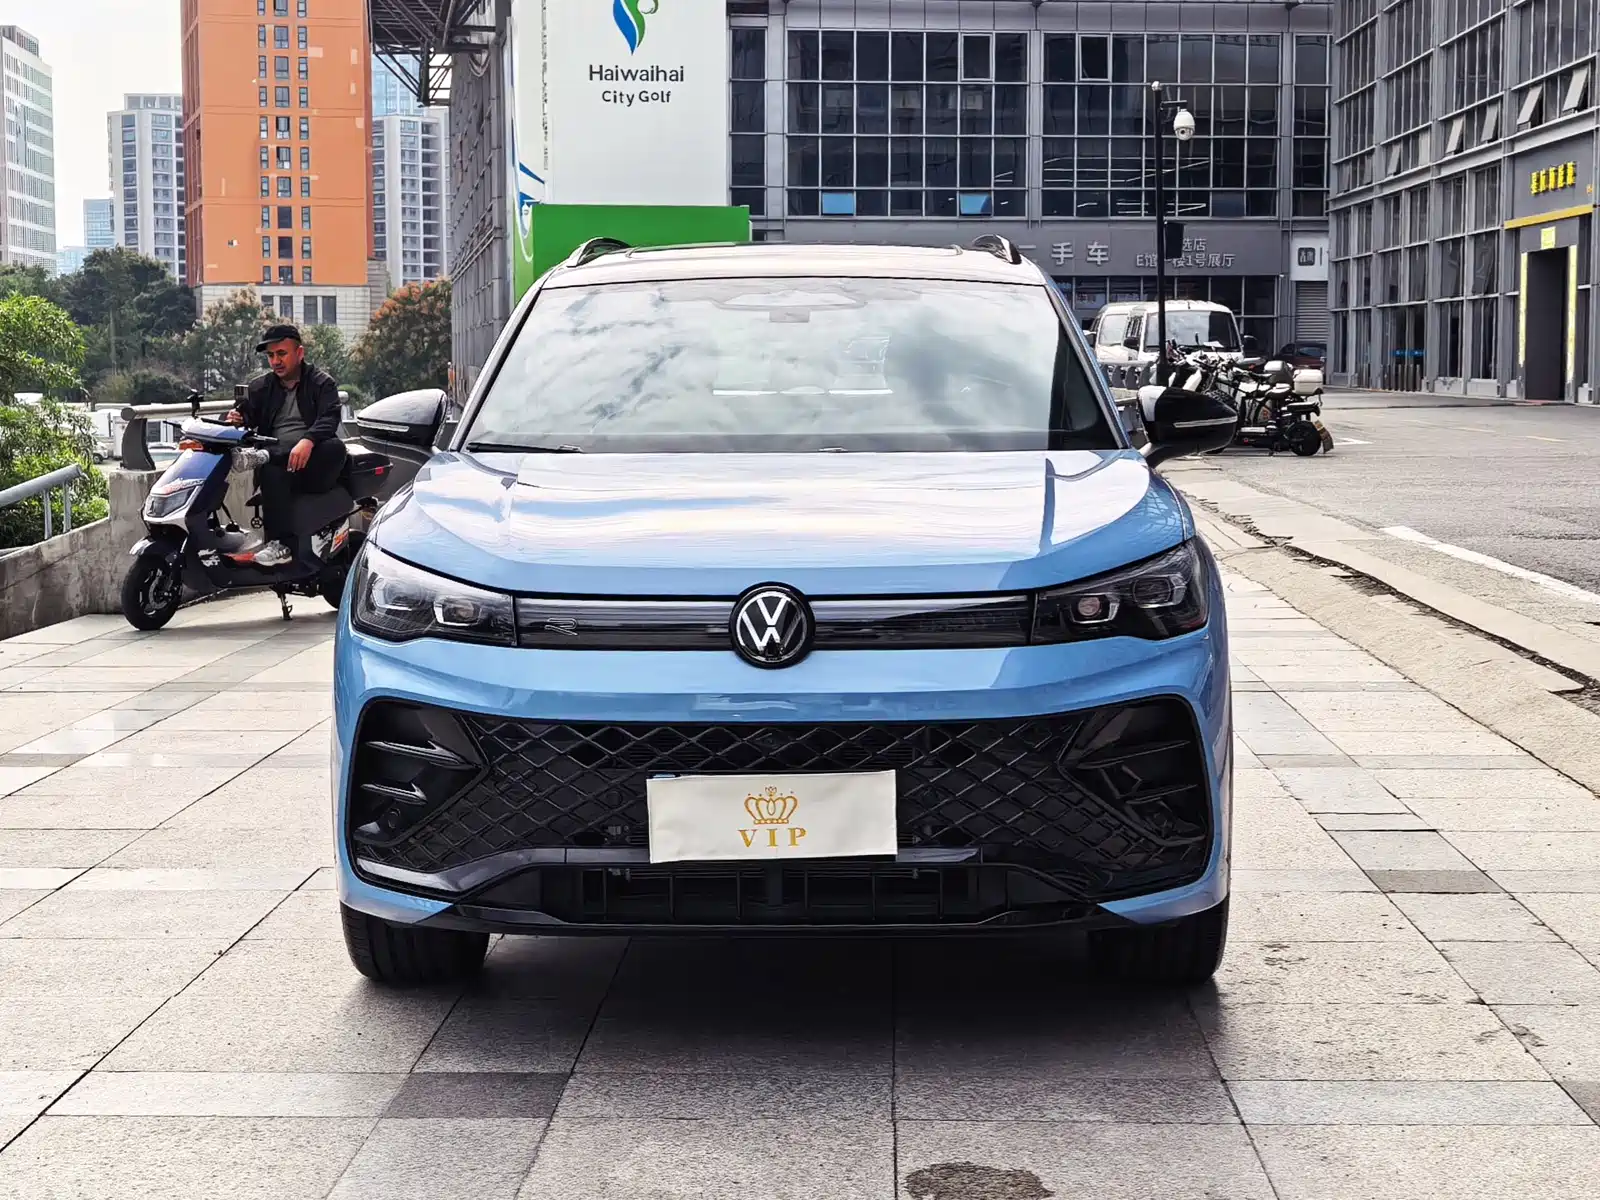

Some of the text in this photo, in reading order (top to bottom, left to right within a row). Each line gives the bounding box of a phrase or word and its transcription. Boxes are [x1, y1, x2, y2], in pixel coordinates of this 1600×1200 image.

[588, 64, 684, 82] Haiwaihai
[601, 90, 671, 107] City Golf
[737, 827, 807, 847] VIP
